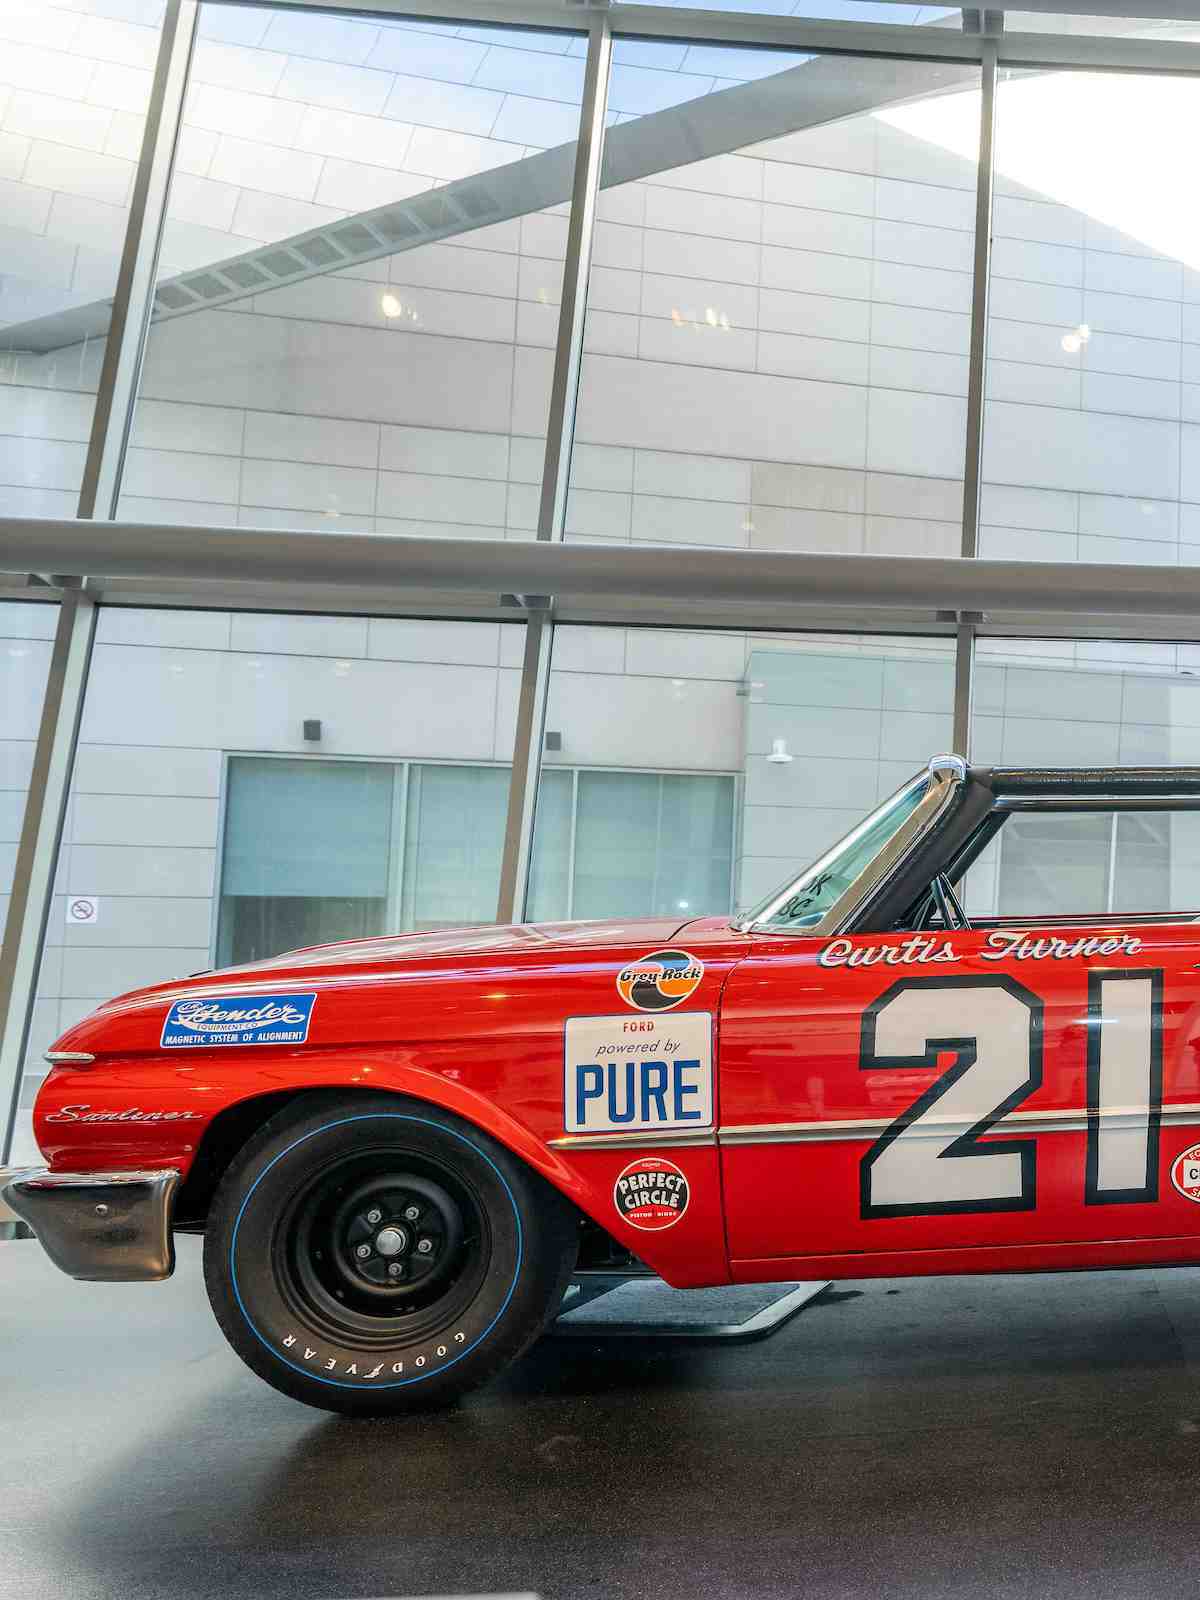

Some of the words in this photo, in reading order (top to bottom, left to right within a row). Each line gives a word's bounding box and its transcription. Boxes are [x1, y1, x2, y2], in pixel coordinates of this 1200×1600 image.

[818, 935, 962, 968] Curtis
[980, 931, 1143, 961] Turner
[165, 1034, 206, 1045] MAGNETIC
[209, 1033, 239, 1043] SYSTEM
[242, 1032, 253, 1042] OF
[257, 1031, 303, 1042] ALIGNMENT
[623, 1021, 655, 1032] FORD
[595, 1039, 660, 1057] powered
[664, 1038, 681, 1053] by
[576, 1060, 702, 1125] PURE
[860, 968, 1164, 1220] 21
[619, 1172, 684, 1195] PERFECT
[625, 1190, 680, 1209] CIRCLE
[282, 1331, 466, 1379] GOODYEAR
